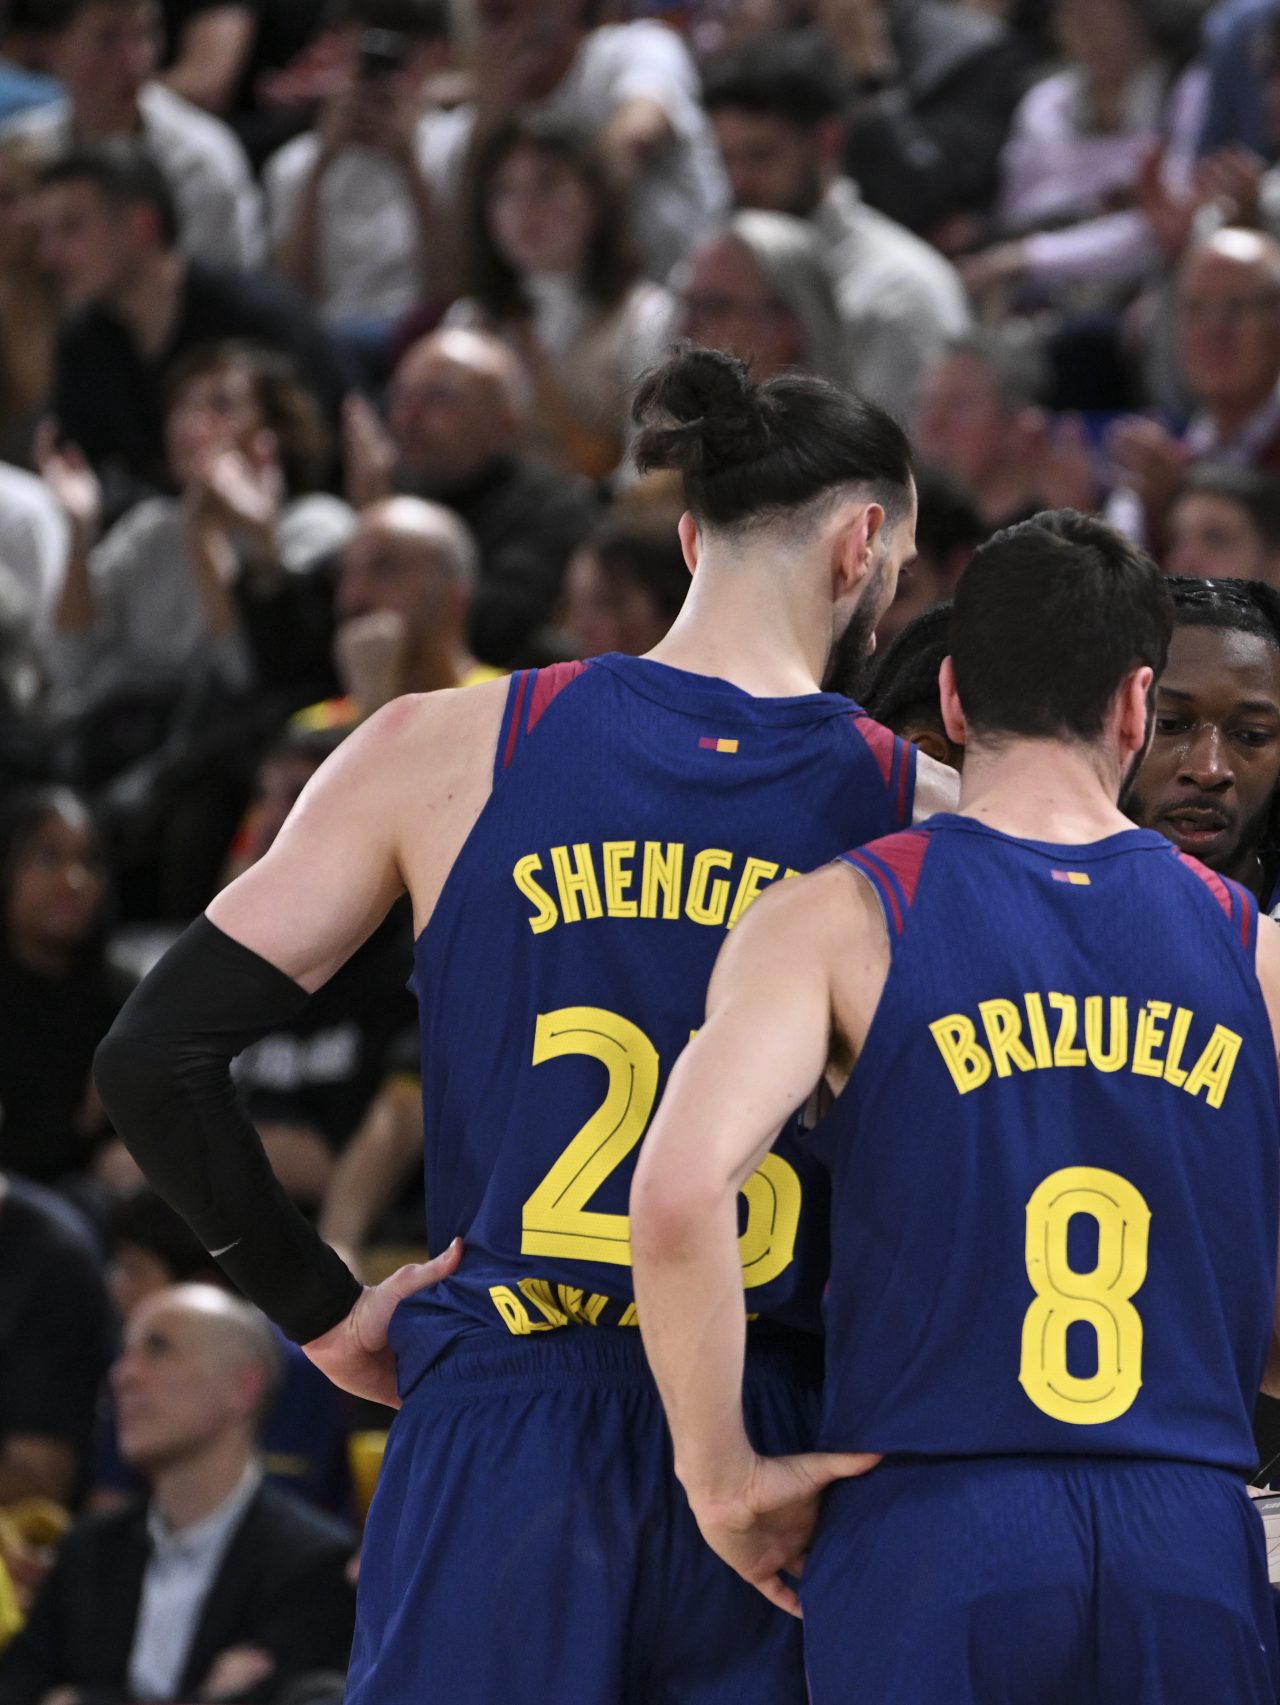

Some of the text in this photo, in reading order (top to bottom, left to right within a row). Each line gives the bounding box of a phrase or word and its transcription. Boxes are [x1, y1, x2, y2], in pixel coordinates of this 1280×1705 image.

[512, 840, 803, 935] SHENGE
[928, 991, 1243, 1110] BRIZUELA
[1019, 1166, 1152, 1425] 8
